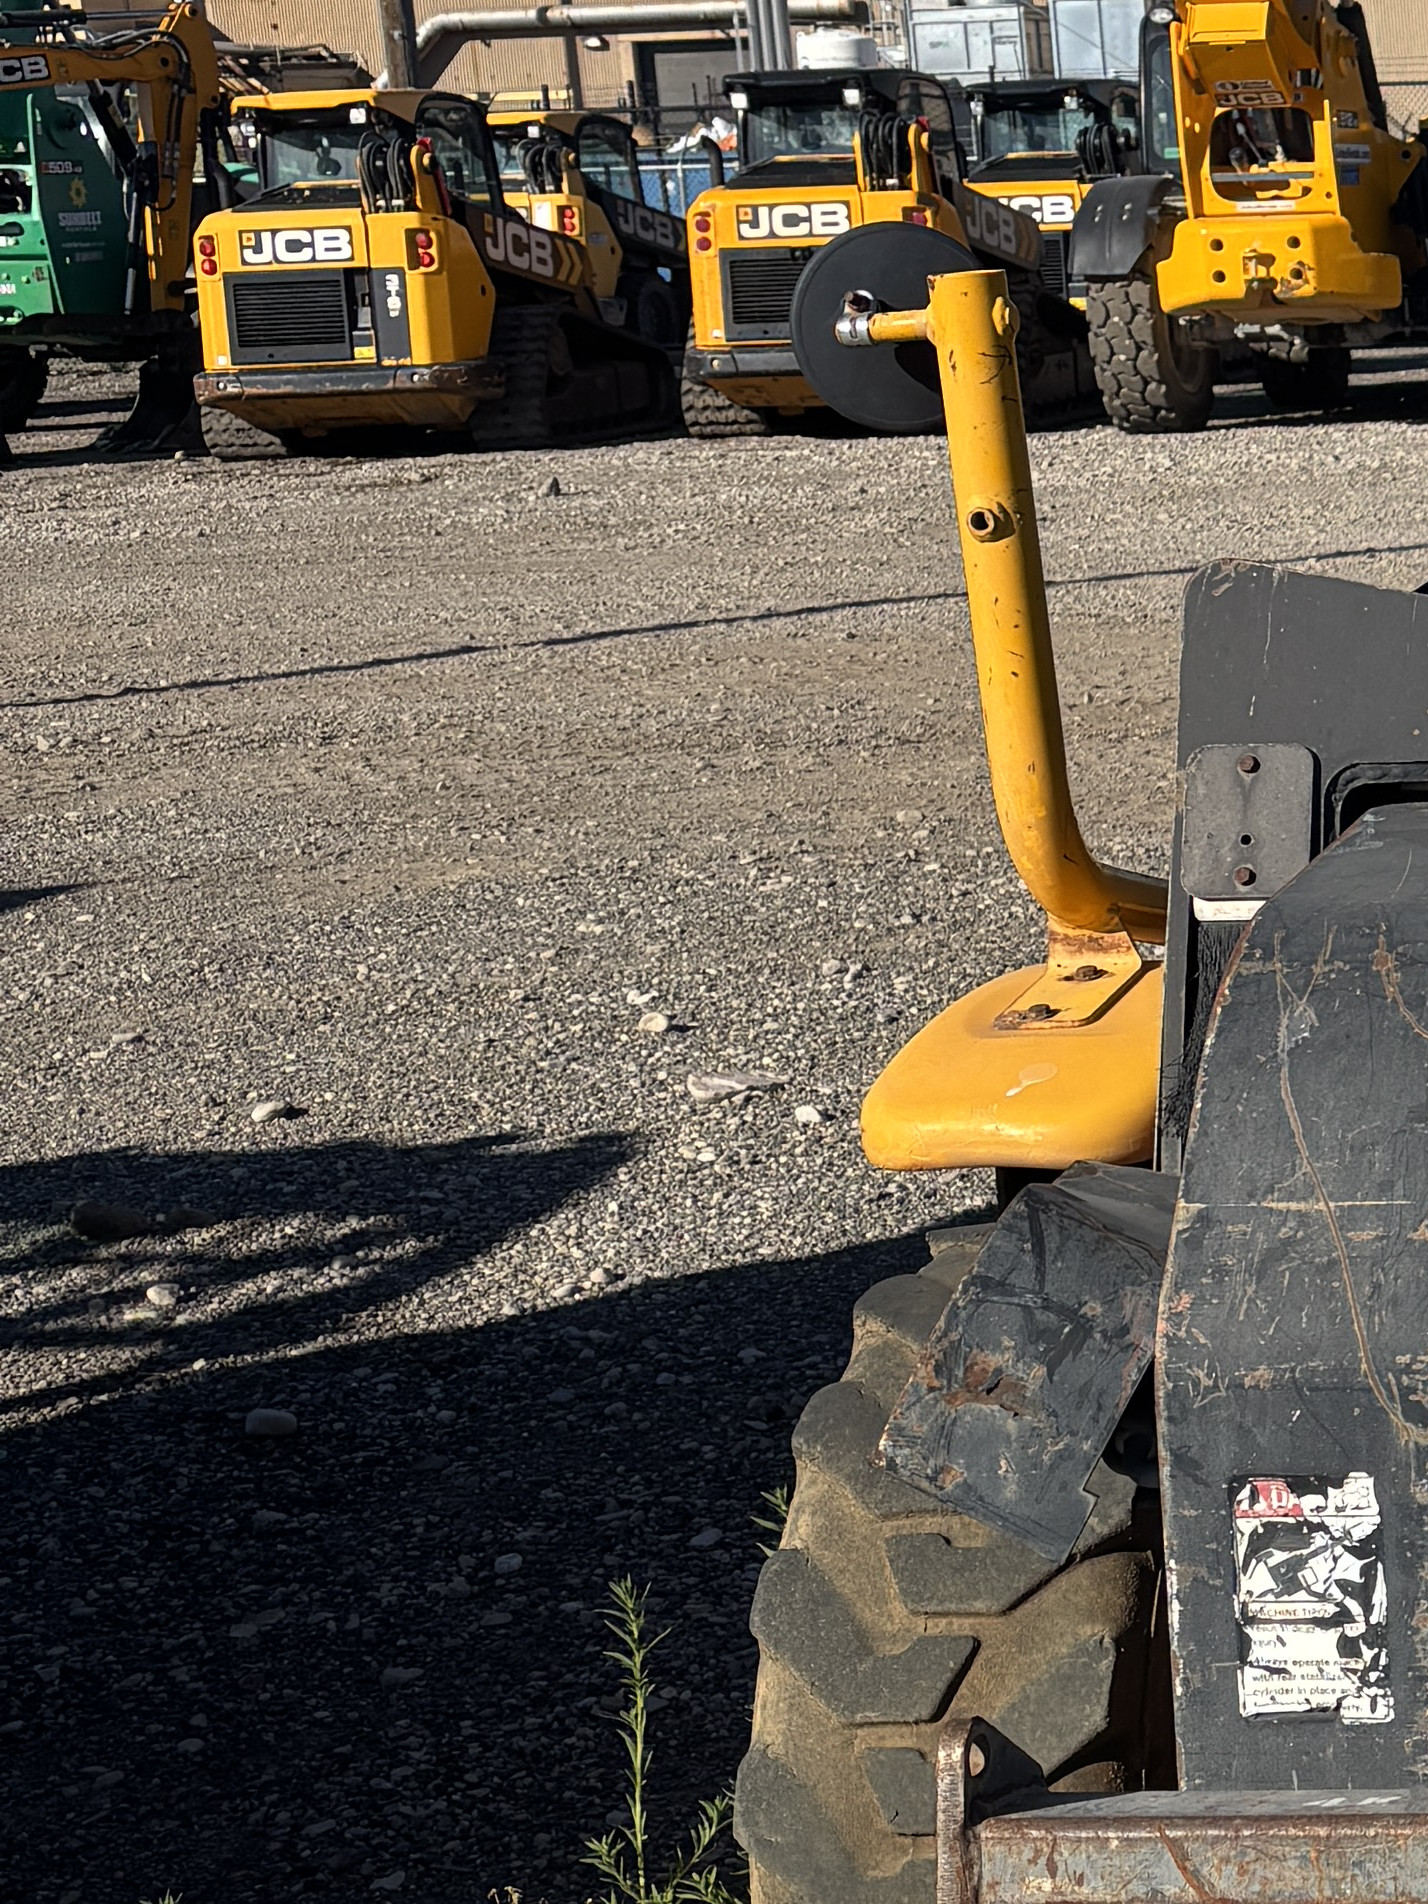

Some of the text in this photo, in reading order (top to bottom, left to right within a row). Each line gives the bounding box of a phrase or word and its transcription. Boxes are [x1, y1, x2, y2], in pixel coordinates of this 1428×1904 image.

[0, 55, 49, 83] CB
[1218, 92, 1285, 106] JCB
[616, 200, 675, 247] JCB
[738, 202, 850, 238] JCB
[966, 199, 1018, 254] JCB
[242, 228, 353, 264] JCB
[484, 214, 554, 277] JCB
[1292, 1658, 1330, 1668] operate
[1310, 1686, 1337, 1696] place
